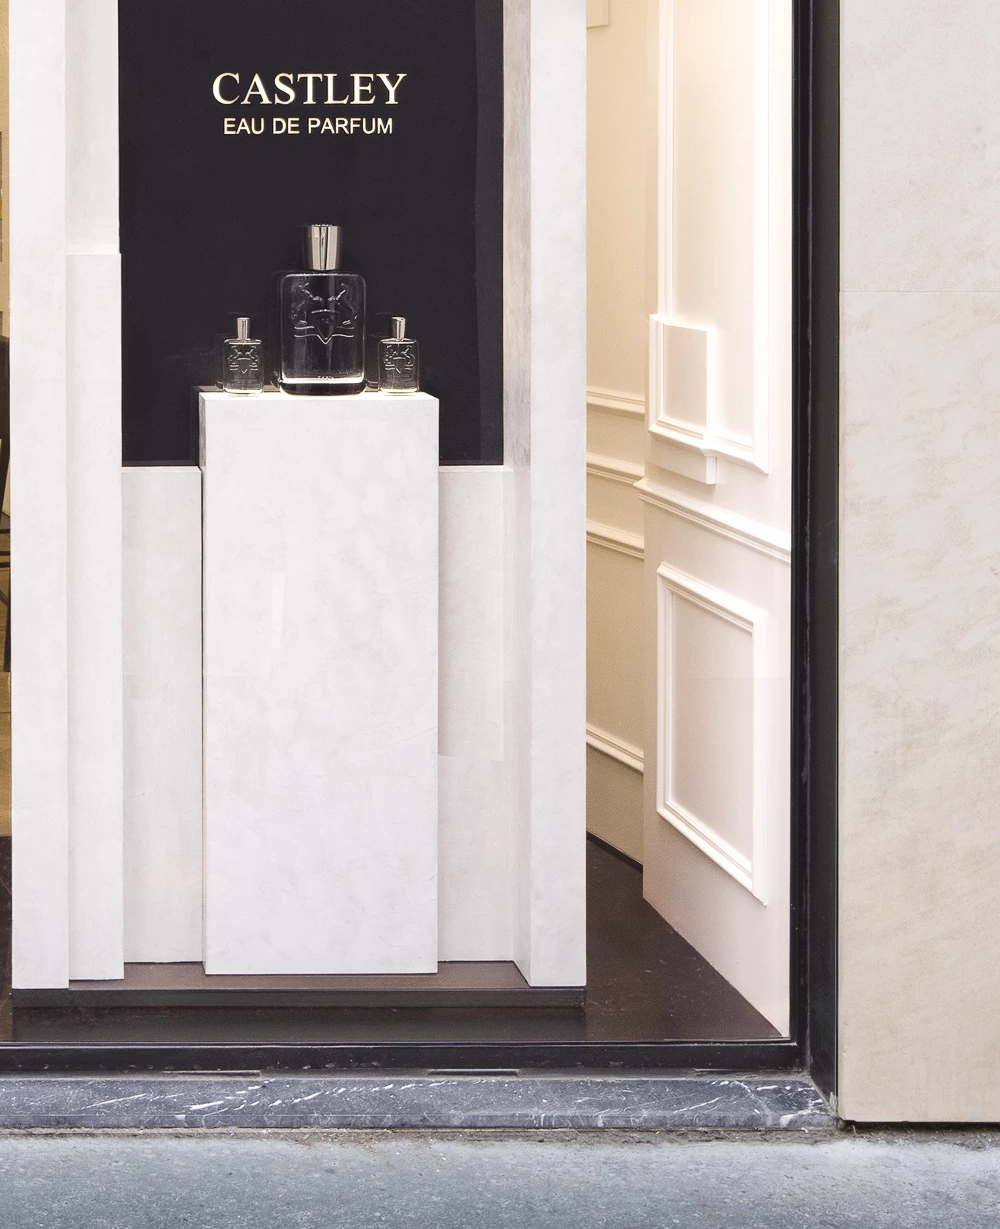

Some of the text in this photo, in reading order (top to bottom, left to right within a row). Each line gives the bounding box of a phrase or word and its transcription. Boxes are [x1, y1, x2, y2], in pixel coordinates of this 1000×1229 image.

[212, 72, 408, 105] CASTLEY
[223, 117, 393, 135] EAU DE PARFUM
